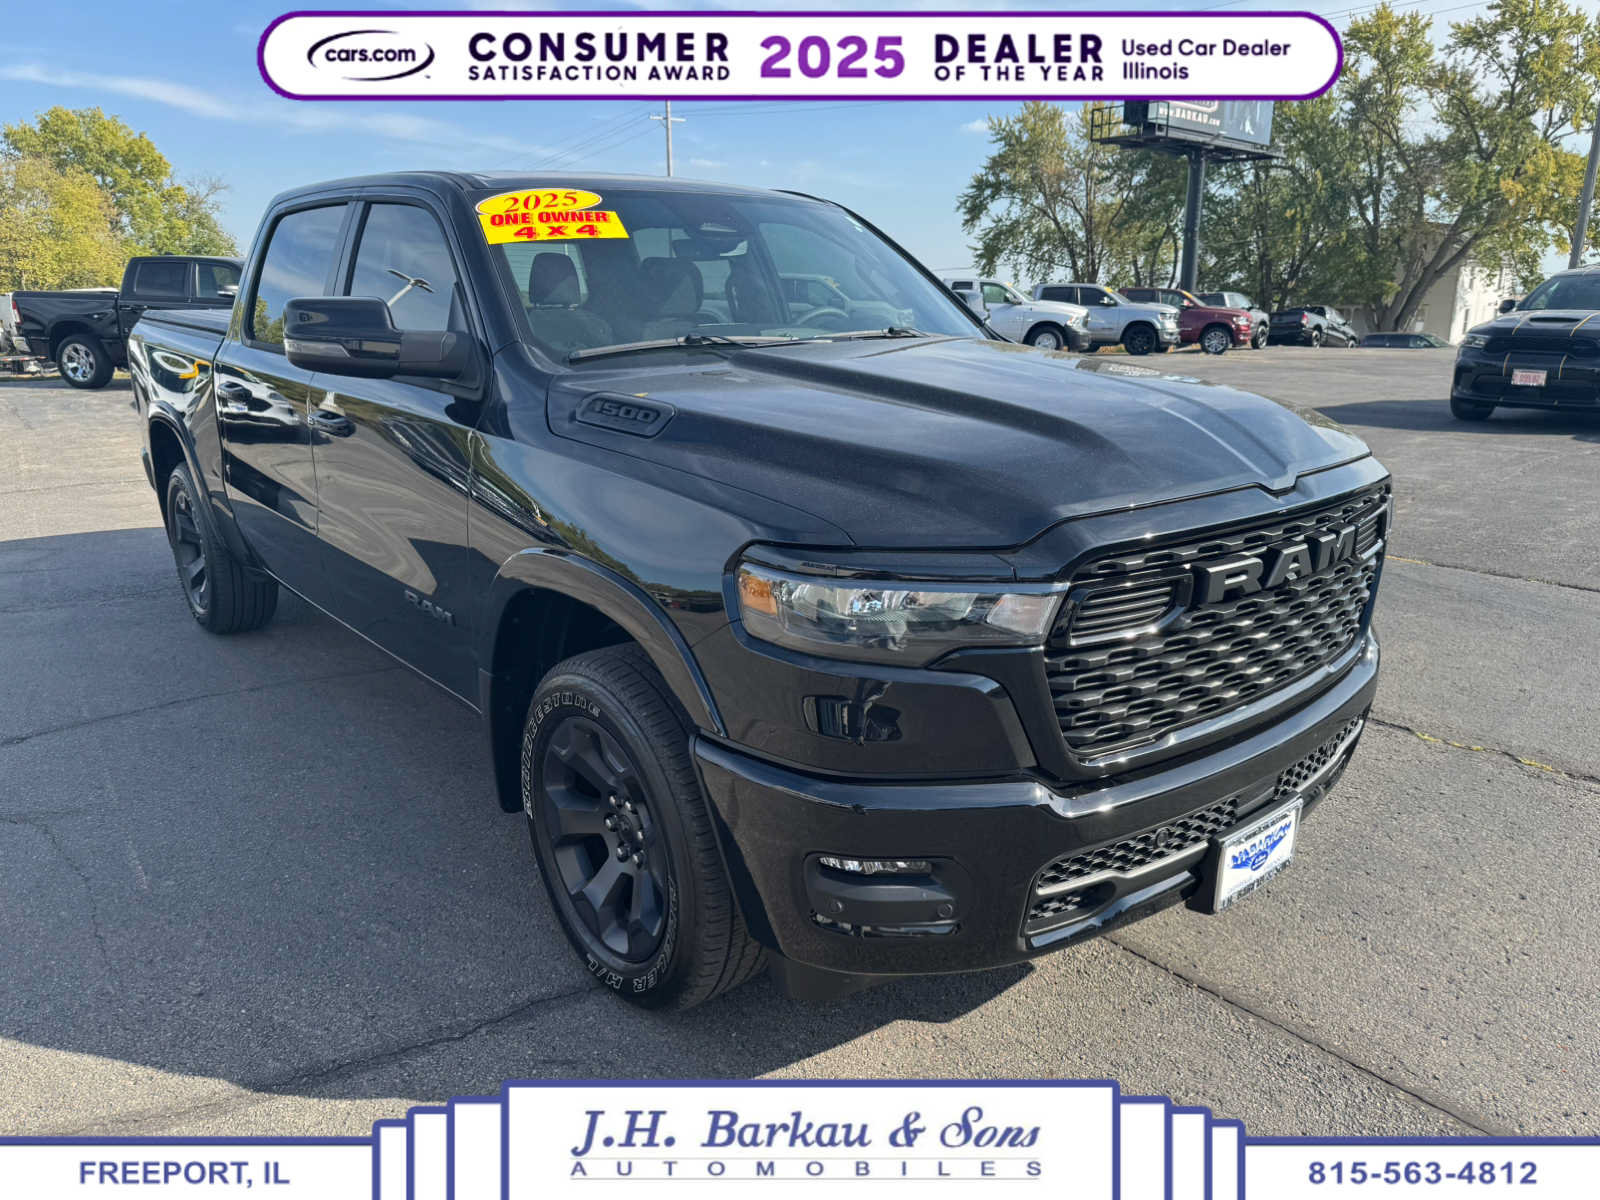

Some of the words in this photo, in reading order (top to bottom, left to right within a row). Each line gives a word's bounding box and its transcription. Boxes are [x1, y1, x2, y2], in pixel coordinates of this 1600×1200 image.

[503, 192, 578, 213] 2025
[490, 213, 531, 227] ONE
[537, 211, 608, 224] OWNER
[513, 226, 539, 239] 4
[575, 224, 601, 237] 4
[593, 400, 658, 422] 1500
[1195, 522, 1356, 603] RAM
